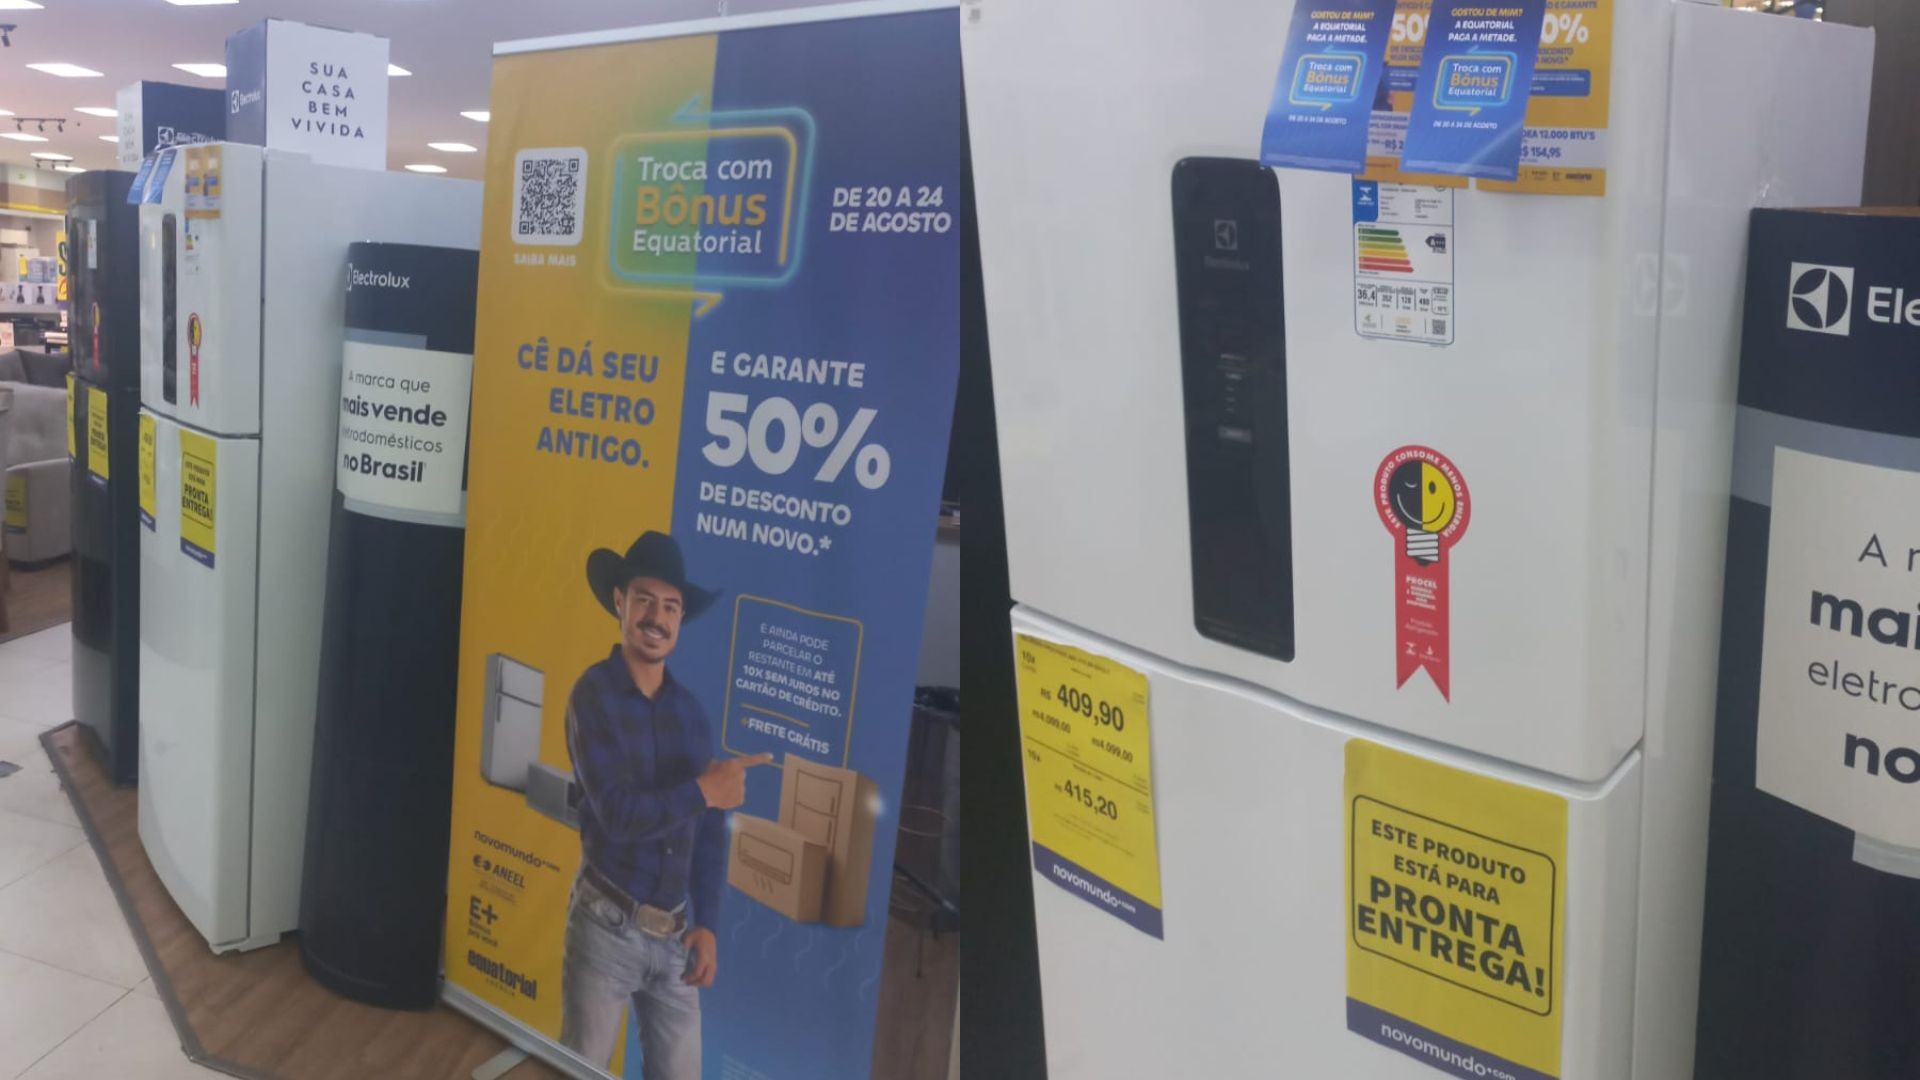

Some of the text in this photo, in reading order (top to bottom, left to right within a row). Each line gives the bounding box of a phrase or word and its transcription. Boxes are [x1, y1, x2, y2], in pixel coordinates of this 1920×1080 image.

[1311, 11, 1341, 19] GOSTOU
[1451, 8, 1484, 16] GOSTOU
[1498, 9, 1523, 17] MIM?
[1455, 21, 1514, 30] A EQUATORIAL
[1307, 34, 1368, 43] PAGA A METADE.
[1313, 22, 1366, 31] A EQUATORIAL
[1391, 13, 1430, 43] 50
[1448, 33, 1517, 42] PAGA A METADE.
[1540, 12, 1589, 44] 0%
[310, 61, 348, 79] SUA
[1307, 70, 1349, 85] Bônus
[1309, 62, 1353, 72] Troca com
[1450, 73, 1498, 87] Bônus
[1453, 63, 1501, 73] Troca com
[301, 81, 355, 100] CASA
[1304, 84, 1347, 93] Equatorial
[1448, 87, 1496, 97] Equatorial
[308, 101, 348, 118] BEM
[291, 118, 365, 140] VIVIDA
[1473, 121, 1497, 129] AGOSTO
[1539, 130, 1568, 140] 12.000
[638, 156, 773, 182] Troca com
[635, 184, 767, 227] Bônus
[832, 187, 944, 208] DE 20 A 24
[829, 211, 952, 234] DE AGOSTO
[632, 229, 762, 256] Equatorial
[513, 253, 577, 267] SAIBA MAIS
[352, 269, 410, 289] Electrolux
[517, 337, 659, 383] CÊ DÁ SEU
[711, 351, 866, 389] E GARANTE
[355, 372, 395, 390] marca
[400, 378, 431, 395] que
[371, 402, 447, 427] vende
[549, 387, 655, 426] ELETRO
[536, 426, 649, 469] ANTIGO.
[702, 390, 892, 490] 50%
[343, 453, 424, 483] no Brasil
[1394, 449, 1440, 466] CONSOME
[1379, 461, 1396, 506] PRODUTO
[1440, 461, 1463, 500] MENOS
[700, 481, 853, 526] DE DESCONTO
[696, 513, 748, 542] NUM
[1383, 506, 1402, 530] ESTE
[1858, 533, 1888, 568] A
[1405, 575, 1438, 590] PROCEL
[760, 622, 829, 652] E AINDA PODE
[763, 639, 823, 666] PARCELAR O
[748, 651, 836, 684] RESTANTE EM ATÉ
[743, 664, 841, 701] 10X SEM JUROS NO
[736, 678, 842, 718] CARTÃO DE CRÉDITO.
[1057, 683, 1124, 732] 409,90
[787, 725, 830, 754] GRÁTIS
[1844, 732, 1920, 784] no
[1064, 779, 1118, 821] 415,20
[1371, 818, 1527, 885] ESTE PRODUTO
[493, 864, 525, 888] ANEEL
[1393, 853, 1501, 905] ESTÁ PARA
[470, 896, 498, 925] E+
[1369, 875, 1526, 958] PRONTA
[1358, 903, 1546, 999] ENTREGA!
